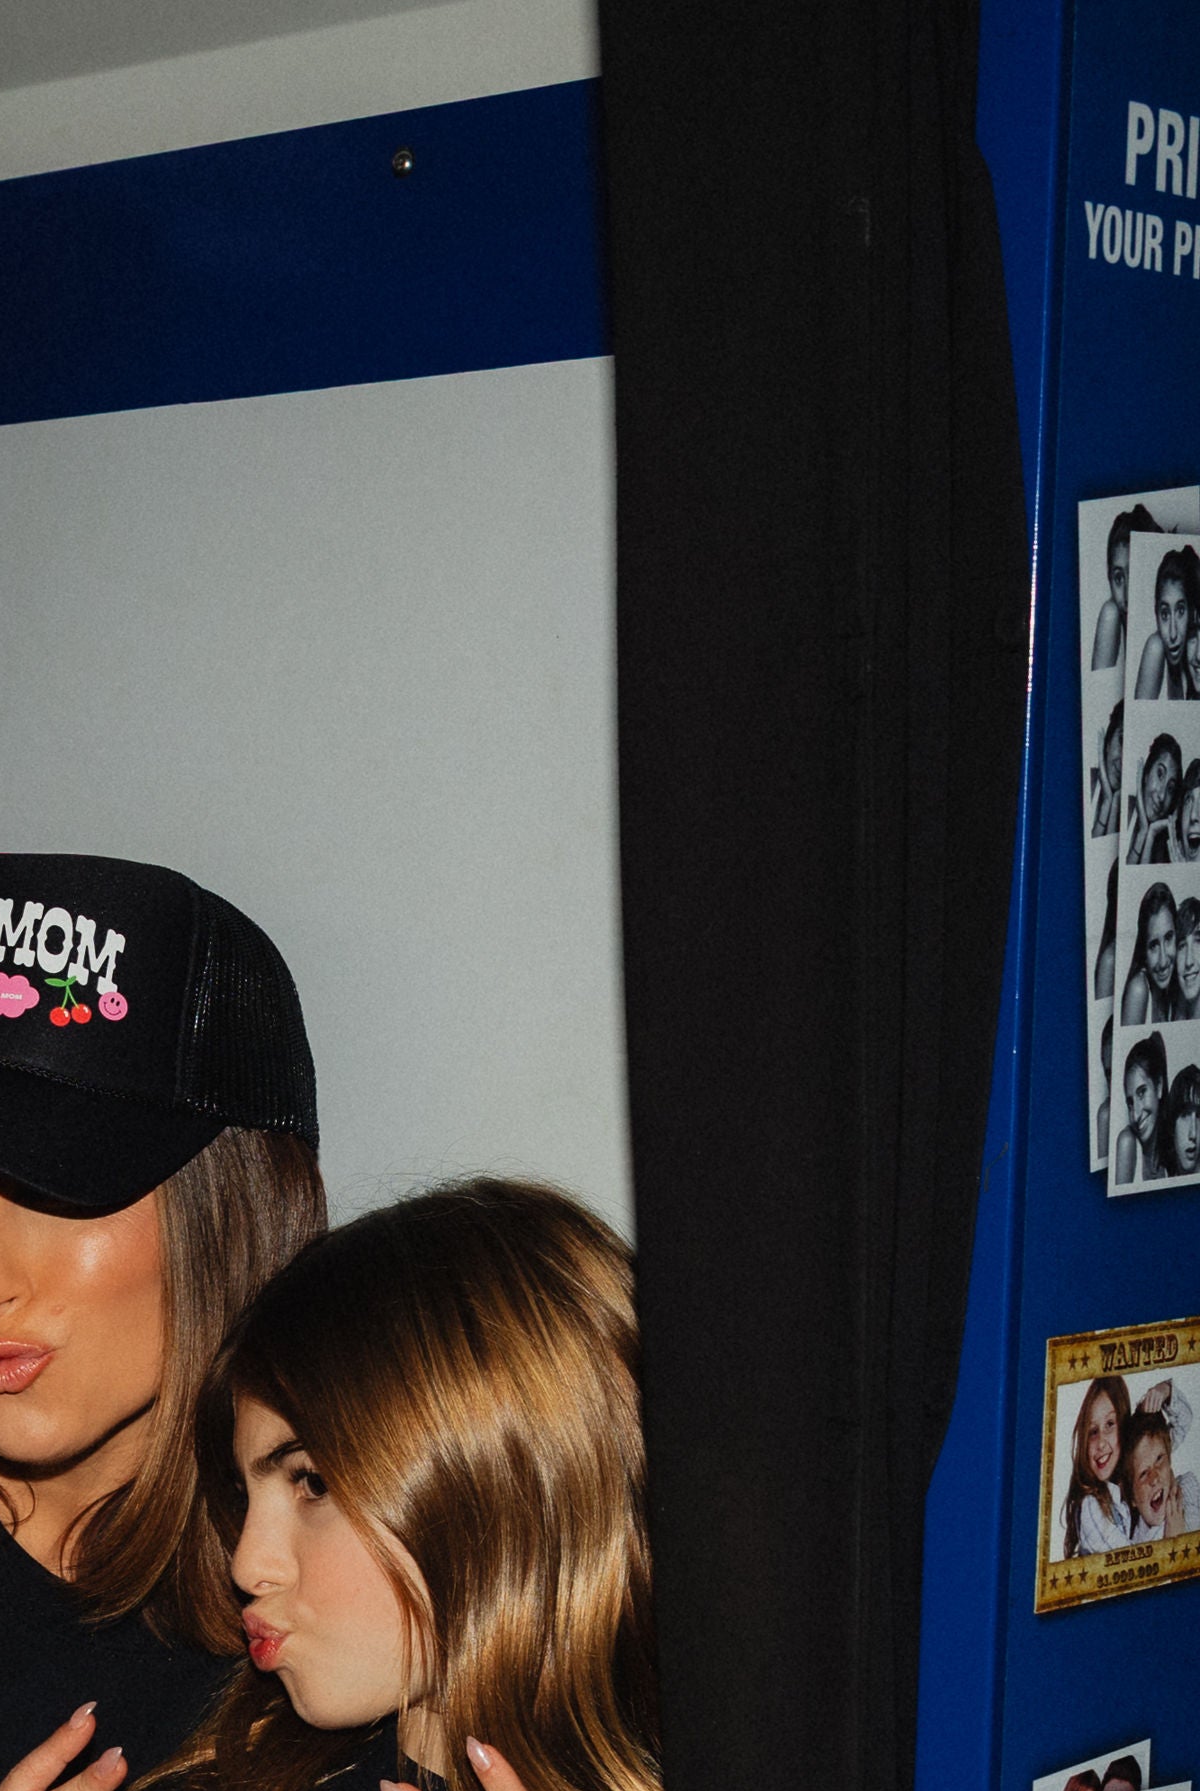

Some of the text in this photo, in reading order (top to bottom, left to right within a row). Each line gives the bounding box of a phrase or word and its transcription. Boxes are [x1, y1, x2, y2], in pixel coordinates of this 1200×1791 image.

[1084, 200, 1164, 272] YOUR
[1099, 1333, 1179, 1373] WANTED
[1104, 1544, 1154, 1567] REWARD
